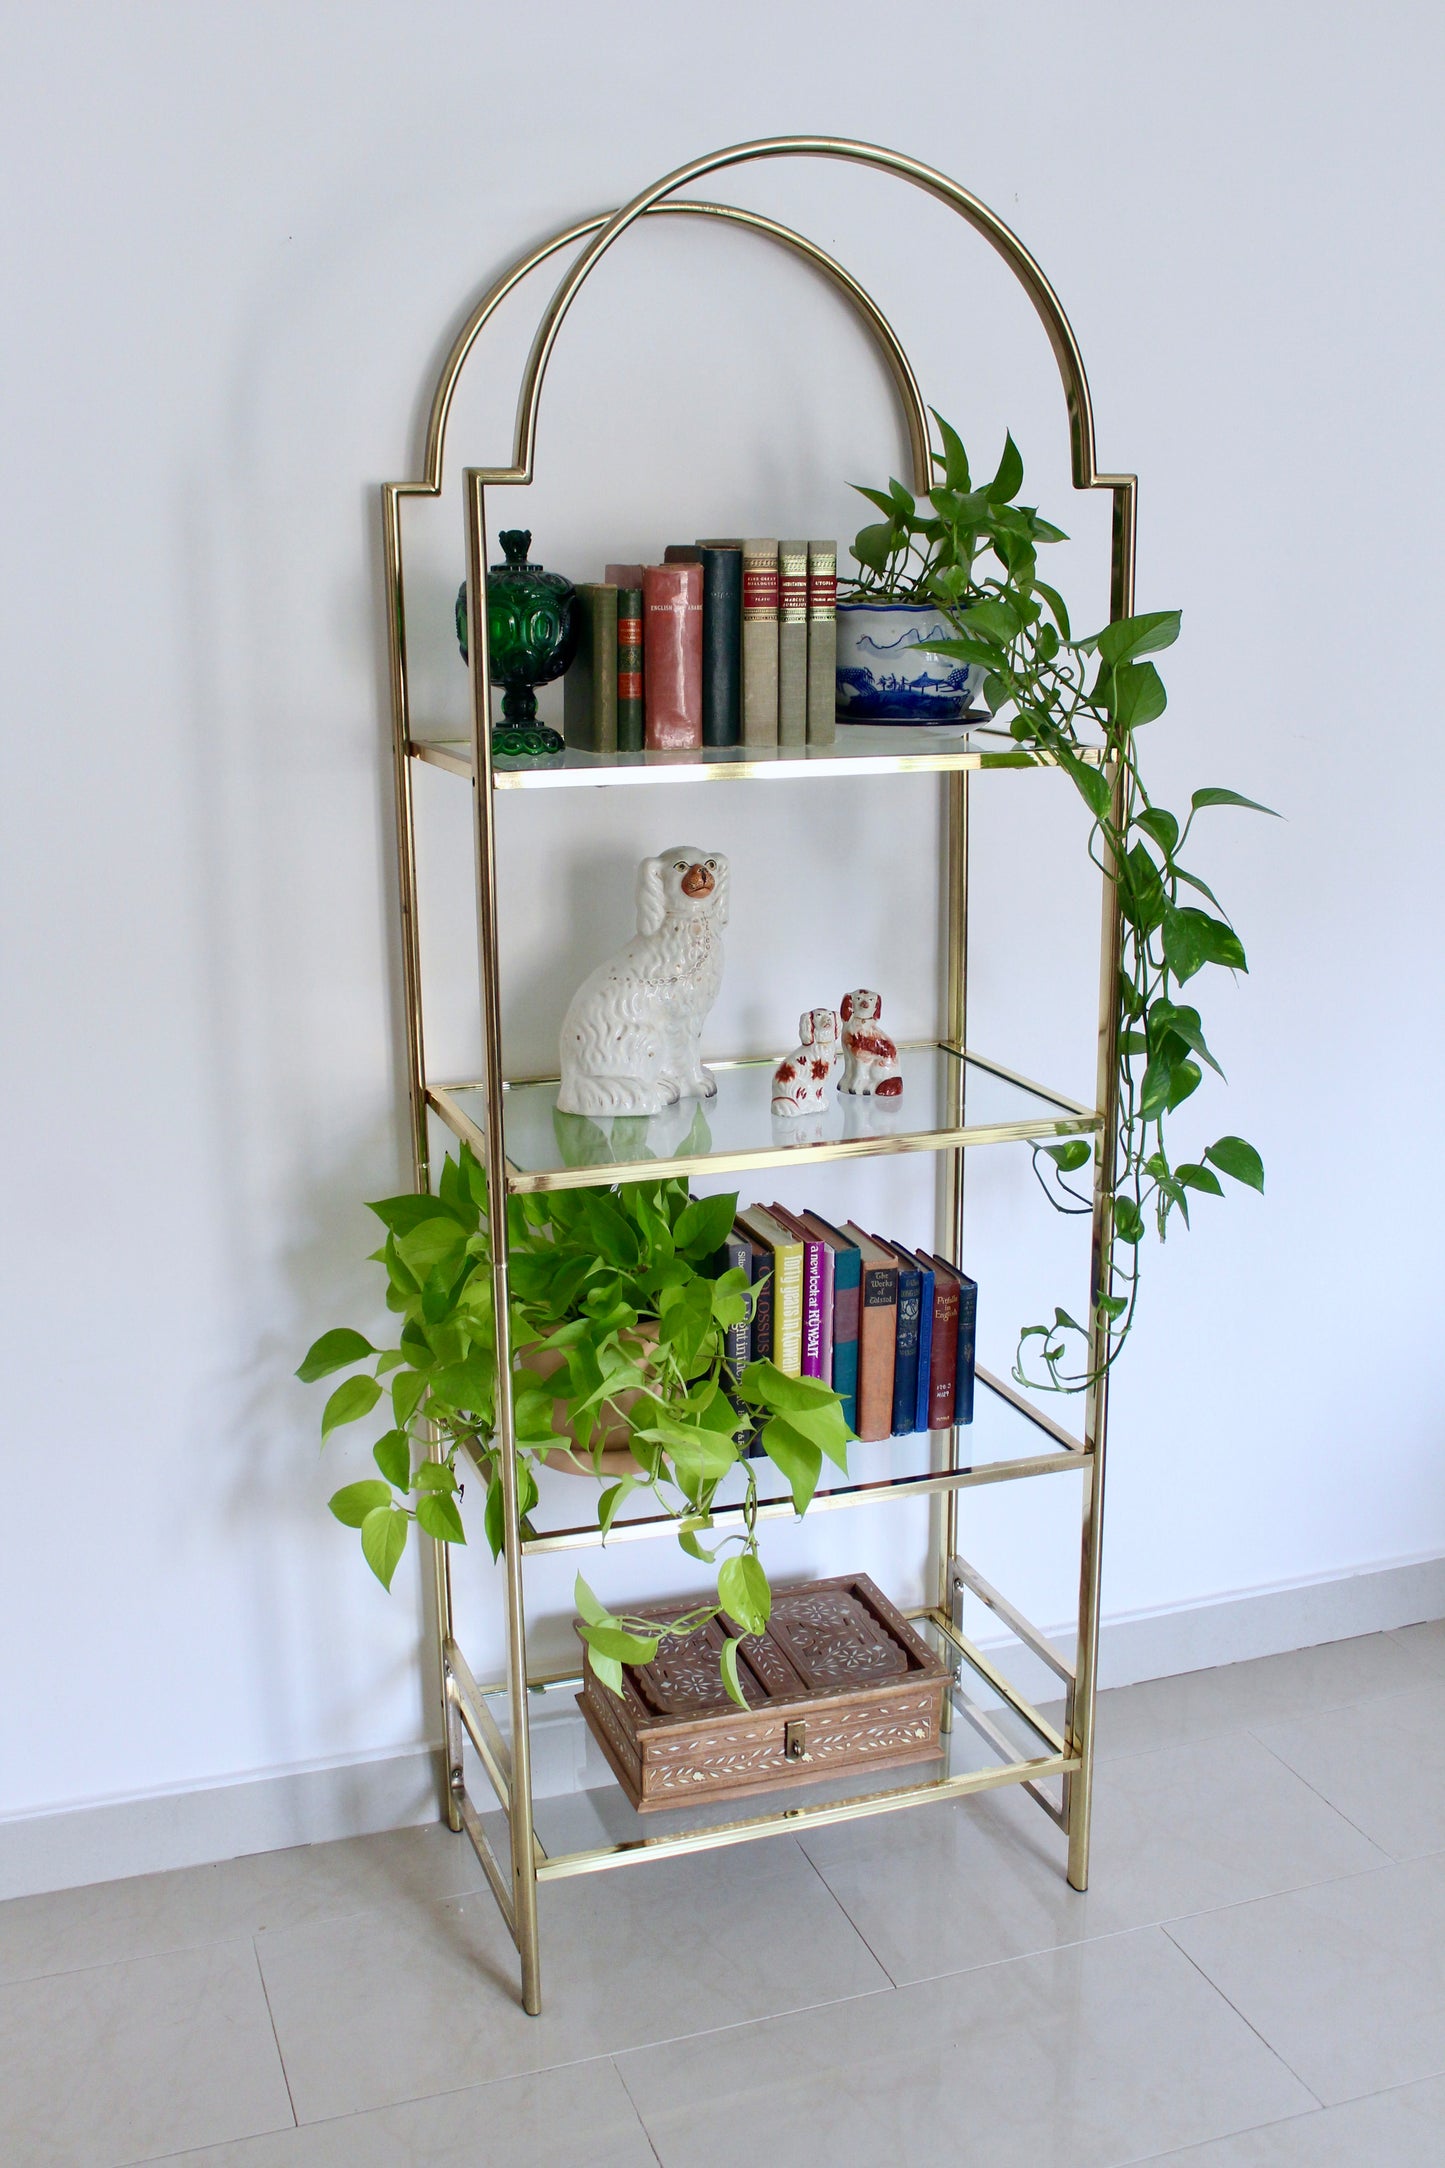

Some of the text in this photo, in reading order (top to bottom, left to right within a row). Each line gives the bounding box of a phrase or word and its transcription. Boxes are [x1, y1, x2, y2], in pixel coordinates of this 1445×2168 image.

[650, 604, 673, 612] ENGLISH
[874, 1271, 889, 1280] The
[870, 1280, 893, 1288] Works
[877, 1288, 885, 1296] of
[807, 1245, 821, 1359] a new look at KUWAIT
[780, 1255, 803, 1373] forty years in Kuwait
[935, 1308, 958, 1321] English
